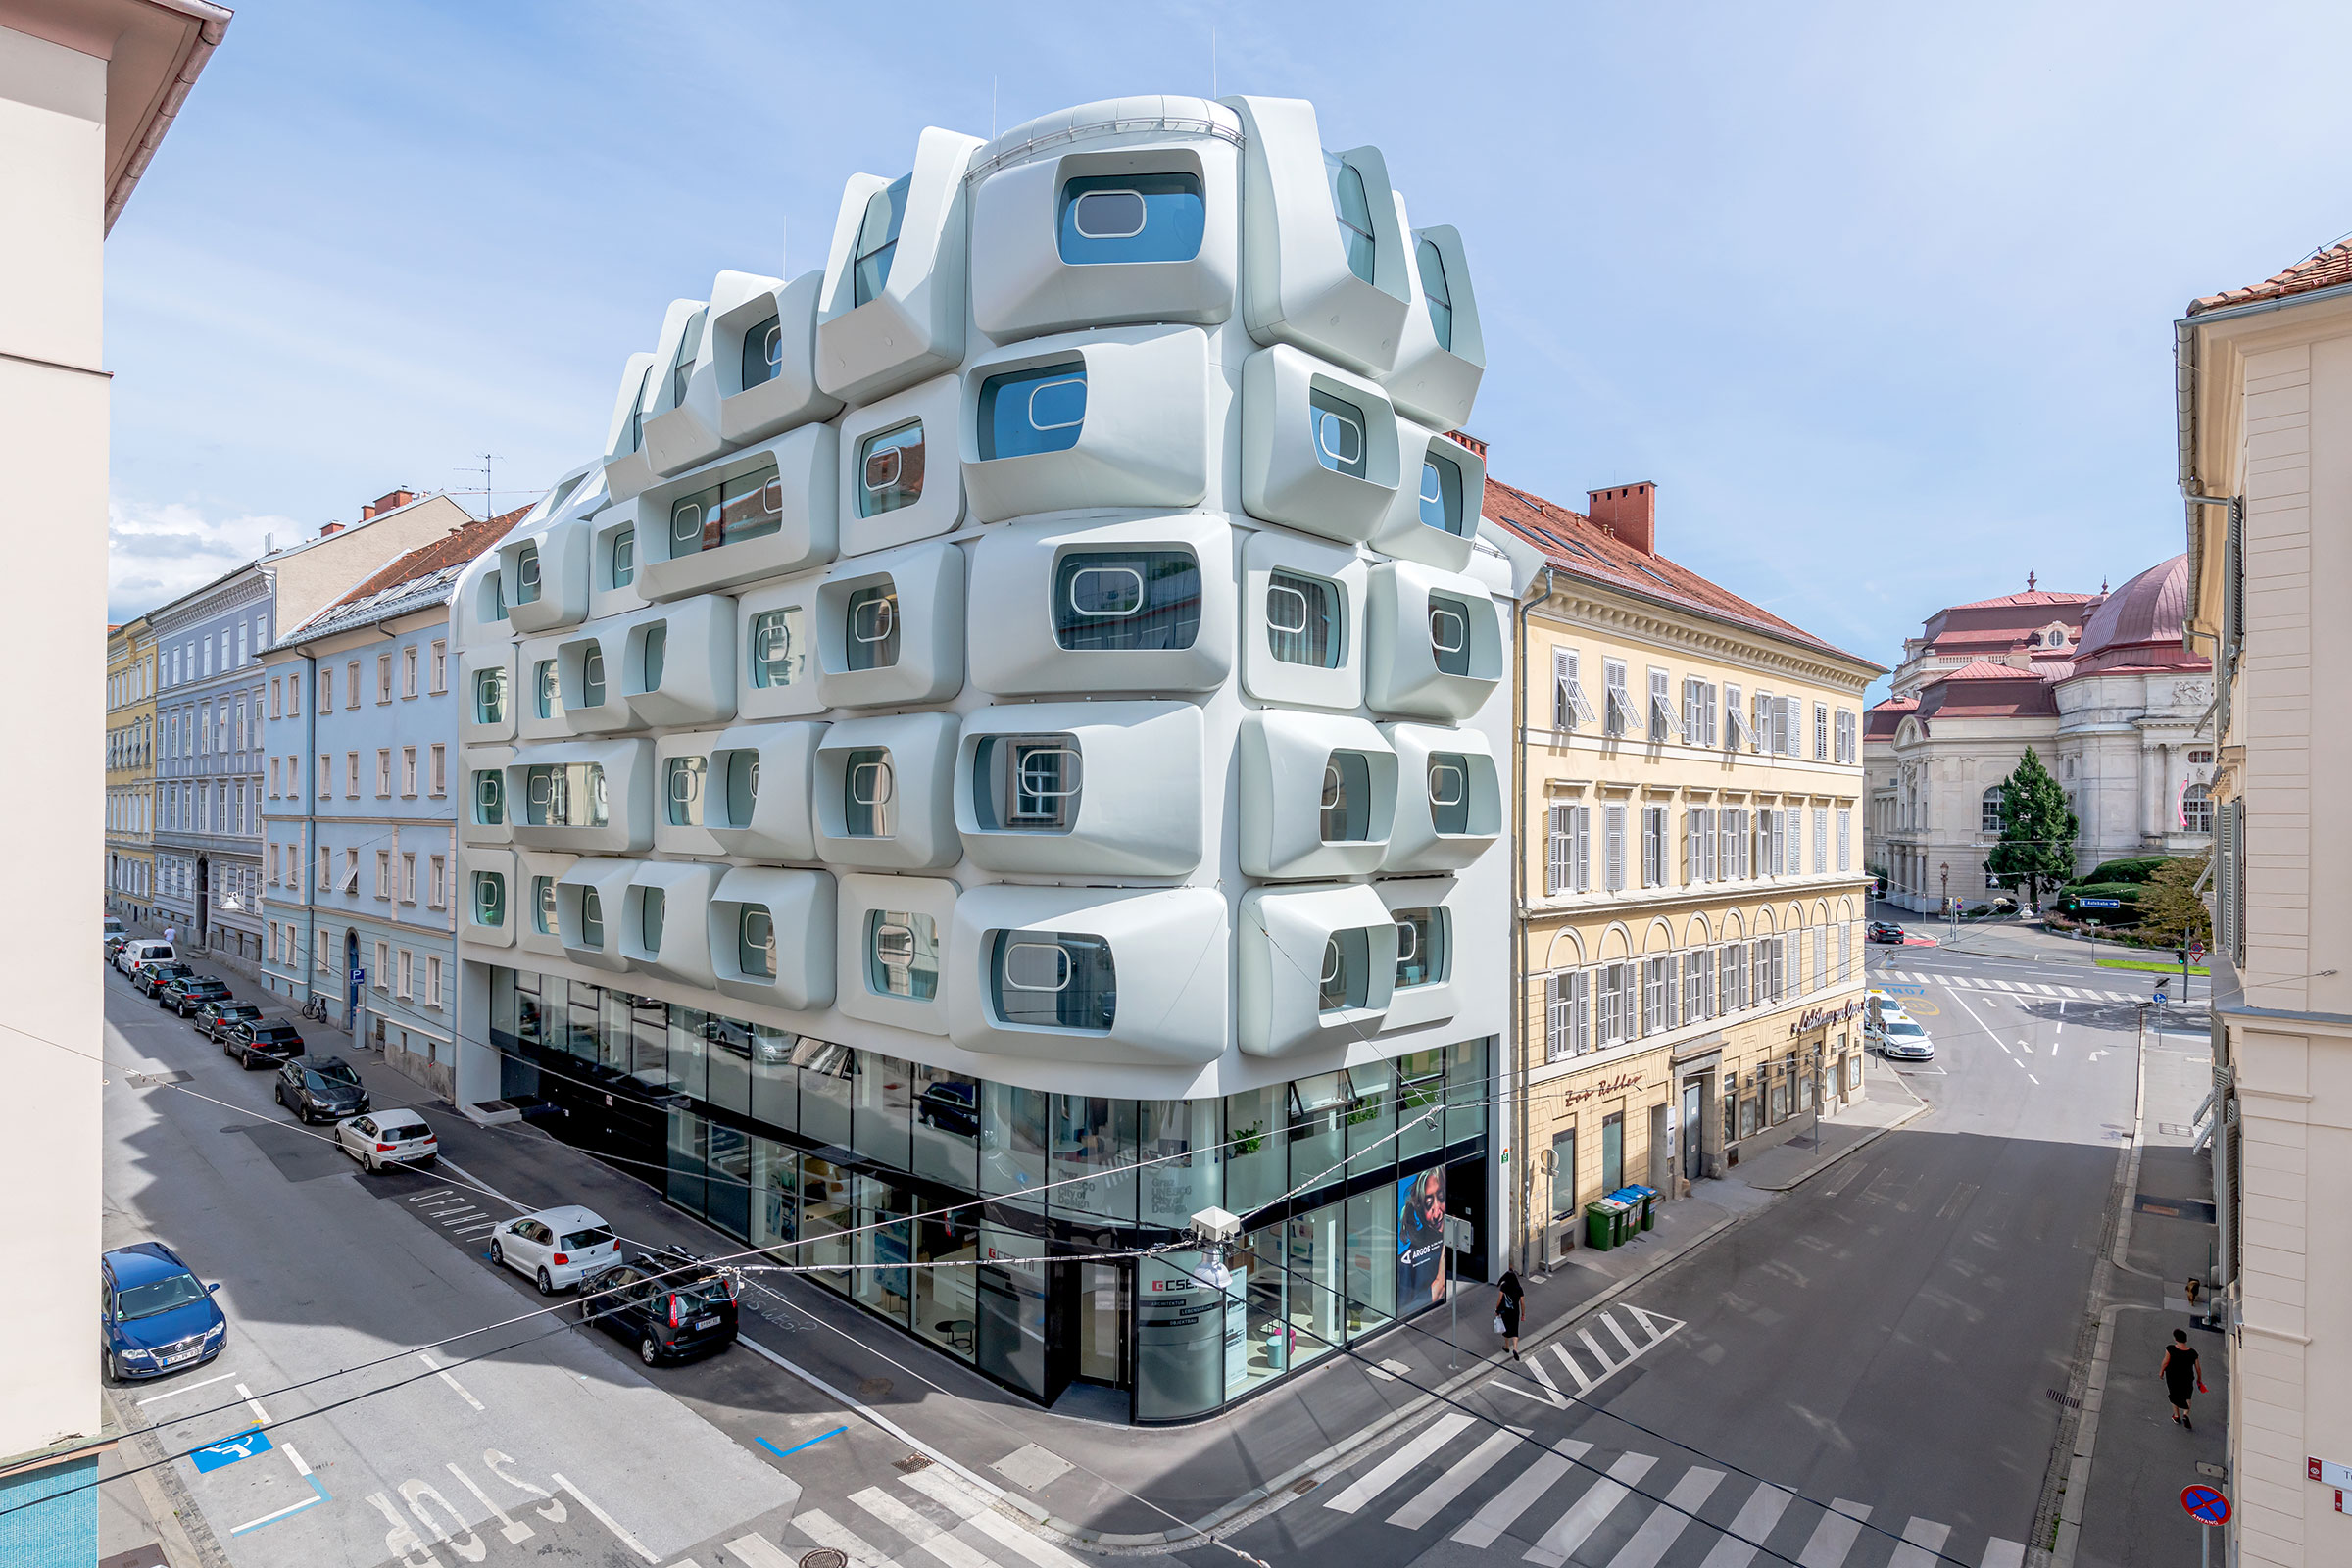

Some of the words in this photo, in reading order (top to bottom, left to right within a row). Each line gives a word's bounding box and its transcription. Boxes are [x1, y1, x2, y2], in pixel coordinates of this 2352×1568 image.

[353, 970, 362, 980] P
[1058, 1186, 1076, 1200] City
[1077, 1191, 1086, 1200] of
[1058, 1196, 1090, 1209] Design
[1412, 1245, 1431, 1259] ARGOS
[1169, 1317, 1198, 1326] OBJEKTBAU
[2191, 1513, 2219, 1526] ANFANG
